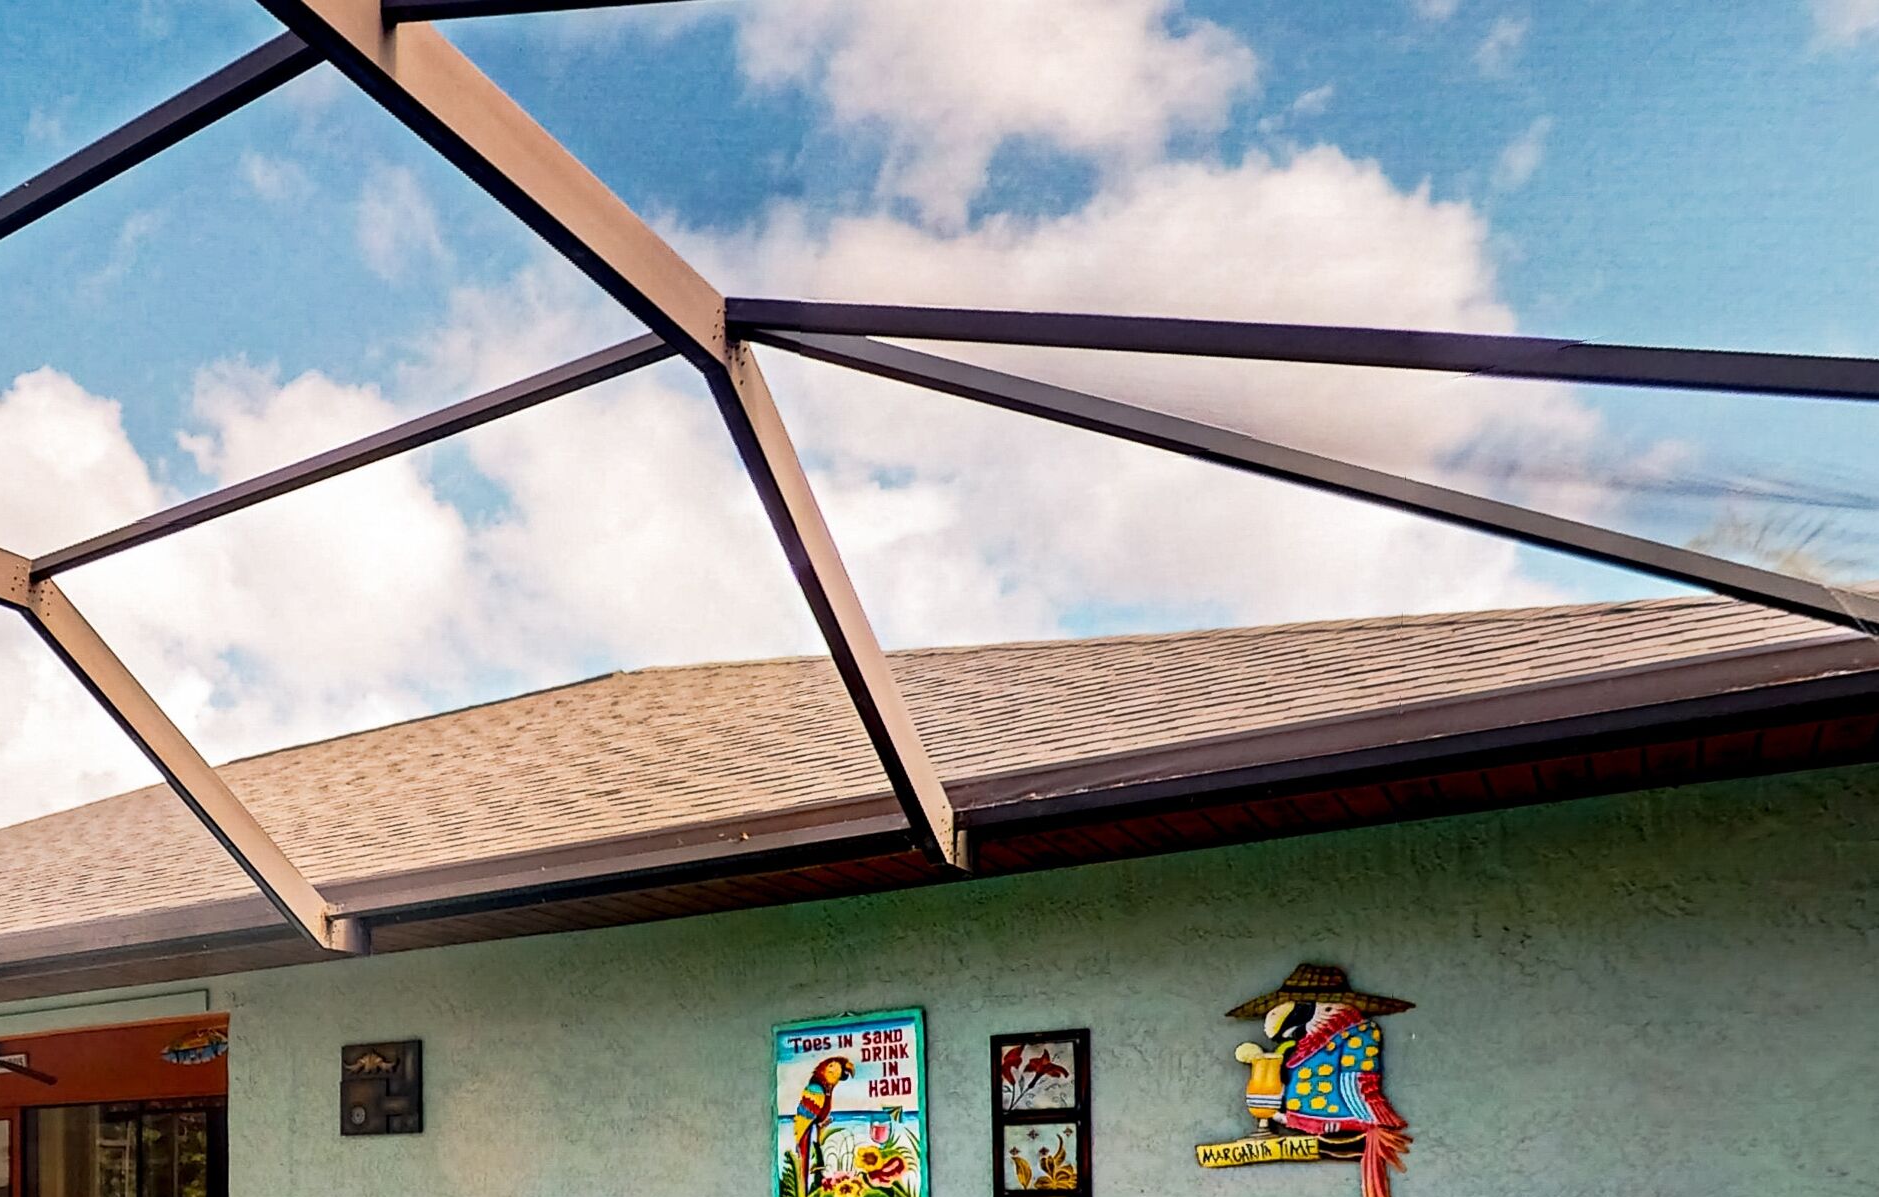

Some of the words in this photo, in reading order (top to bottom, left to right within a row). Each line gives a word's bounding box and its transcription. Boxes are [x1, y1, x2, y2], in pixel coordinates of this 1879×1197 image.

[837, 1033, 853, 1049] IN
[861, 1043, 910, 1063] DRINK
[882, 1061, 899, 1078] IN
[1203, 1141, 1273, 1163] MARGARITA
[1276, 1138, 1319, 1158] TIME
